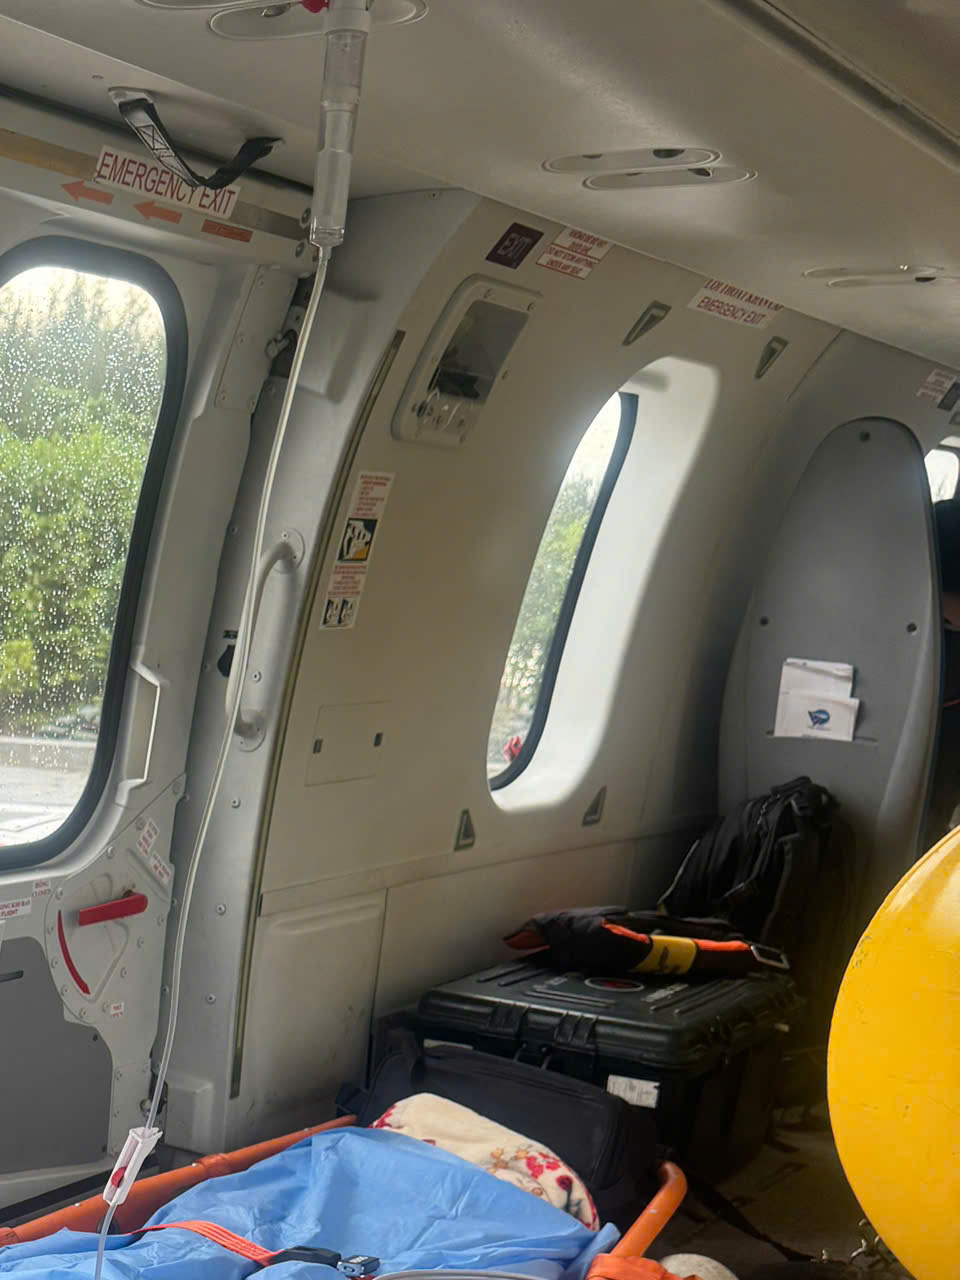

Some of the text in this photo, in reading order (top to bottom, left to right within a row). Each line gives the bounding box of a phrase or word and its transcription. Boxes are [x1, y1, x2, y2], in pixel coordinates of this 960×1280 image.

[198, 186, 236, 214] EXIT
[697, 296, 745, 320] EMERGENCY
[1, 909, 18, 918] FLIGHT
